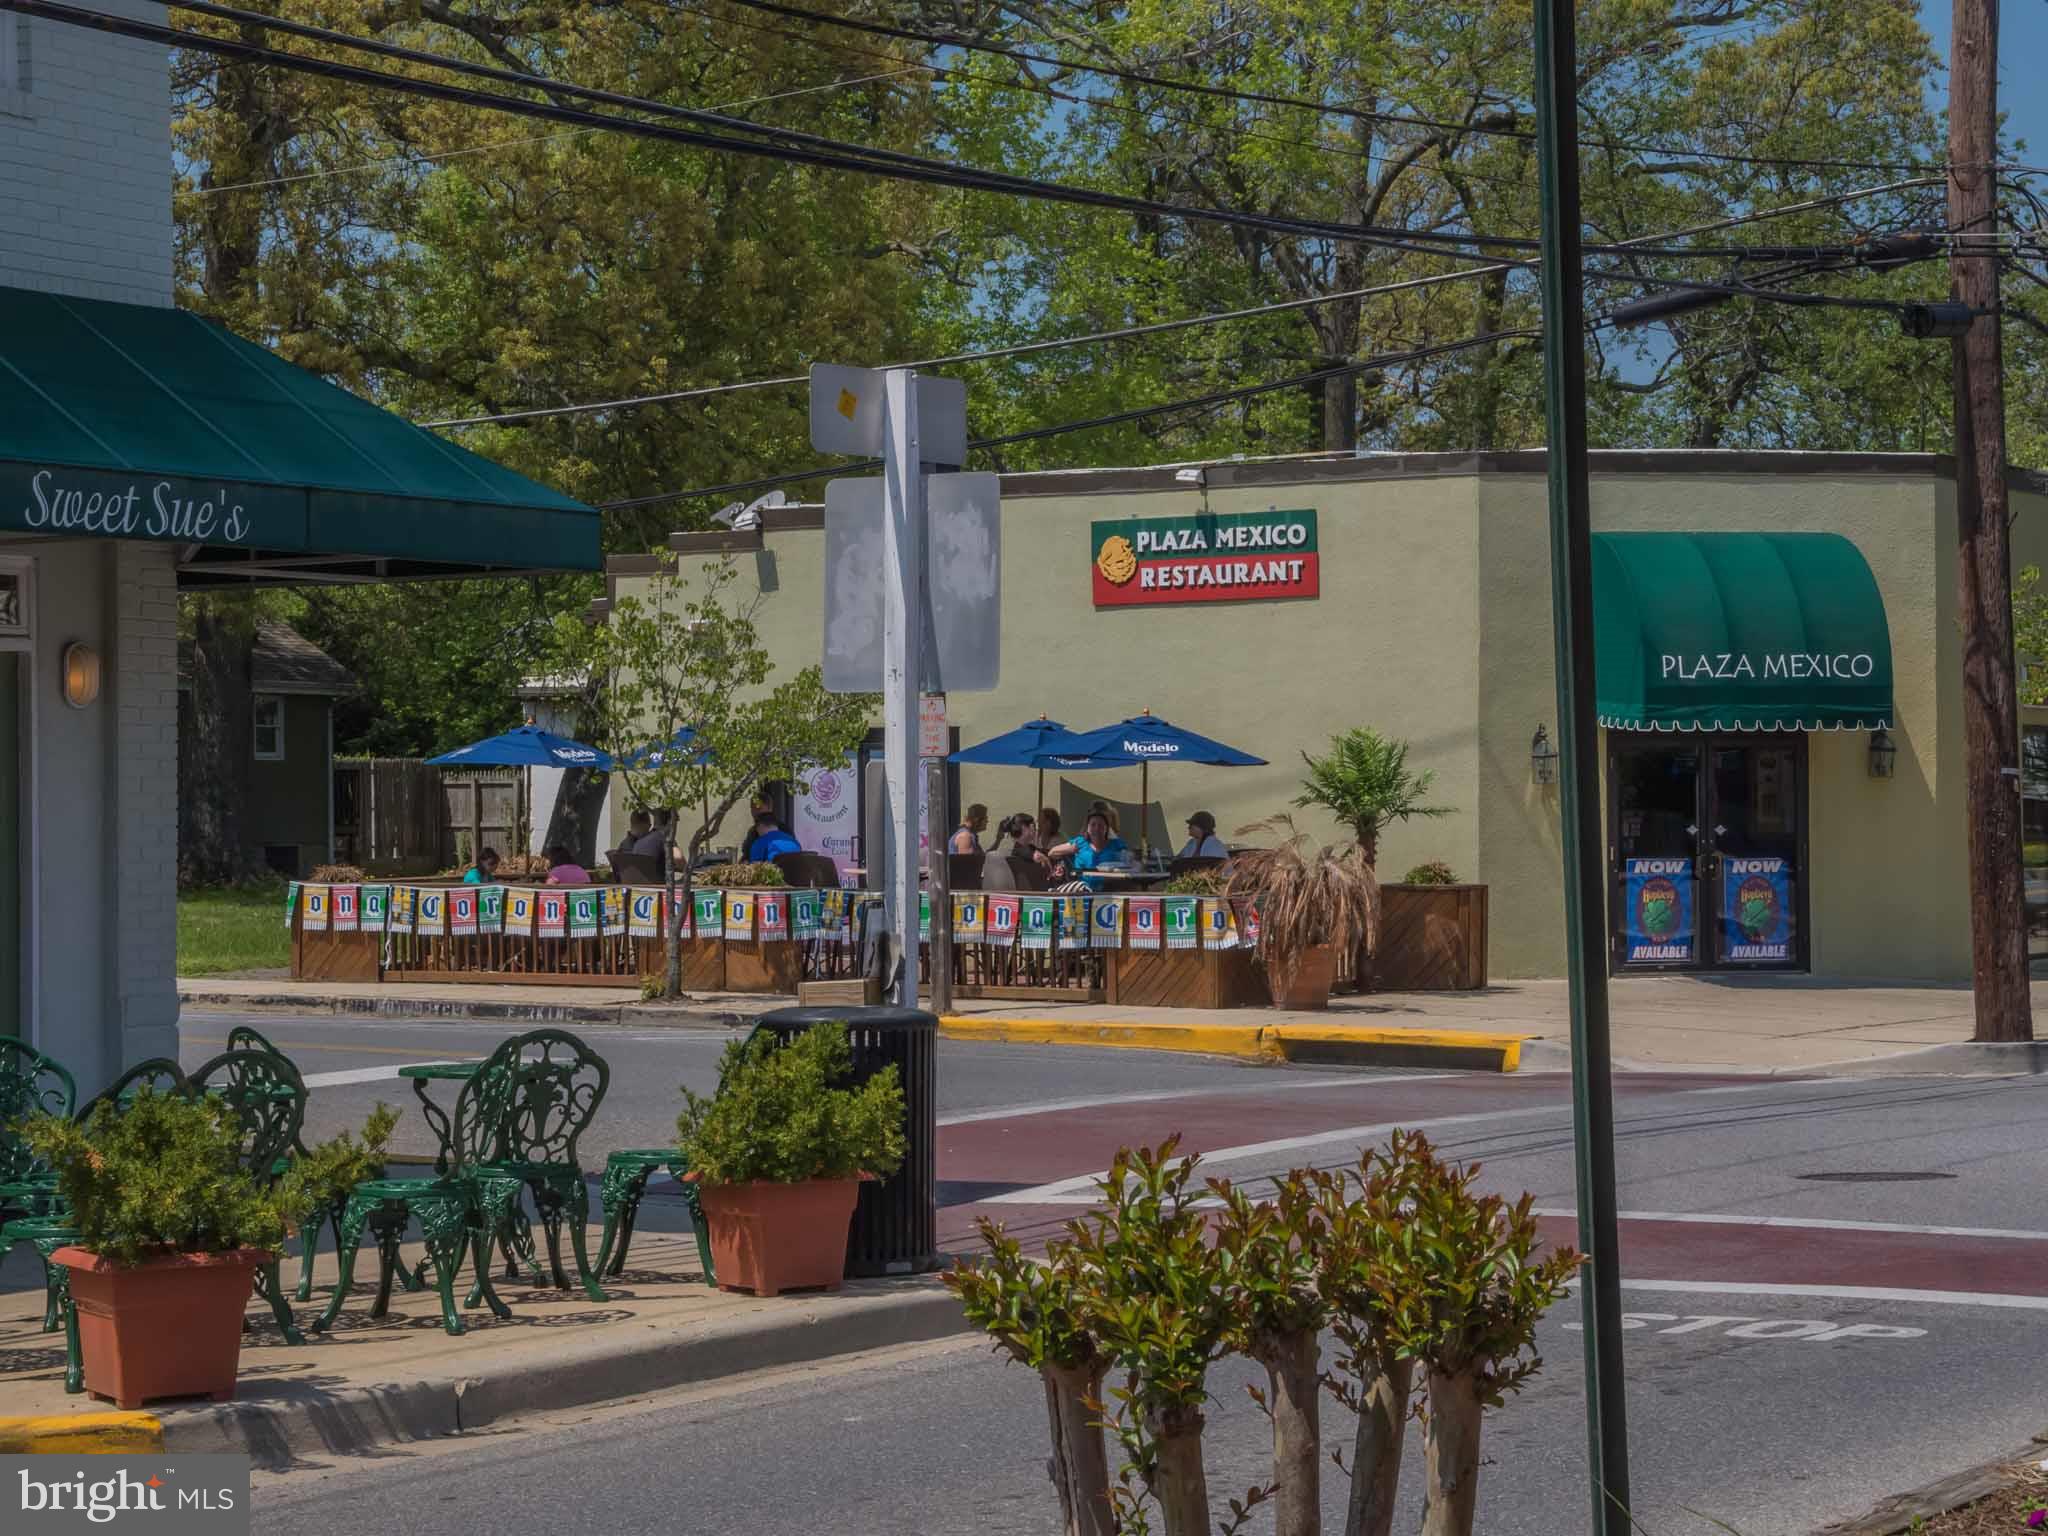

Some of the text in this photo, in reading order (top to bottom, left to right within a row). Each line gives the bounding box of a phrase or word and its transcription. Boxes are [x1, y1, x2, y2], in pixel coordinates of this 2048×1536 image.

[25, 470, 249, 542] Sweet Sue's
[1137, 524, 1307, 552] PLAZA MEXICO
[1140, 560, 1303, 588] RESTAURANT
[1662, 654, 1873, 678] PLAZA MEXICO
[1124, 740, 1179, 752] Modelo
[1634, 861, 1685, 873] NOW
[1732, 861, 1782, 873] NOW
[634, 895, 811, 923] Crona
[1632, 946, 1688, 958] AVAILABLE
[1731, 945, 1787, 958] AVAILABLE
[1562, 1313, 1929, 1342] STOP
